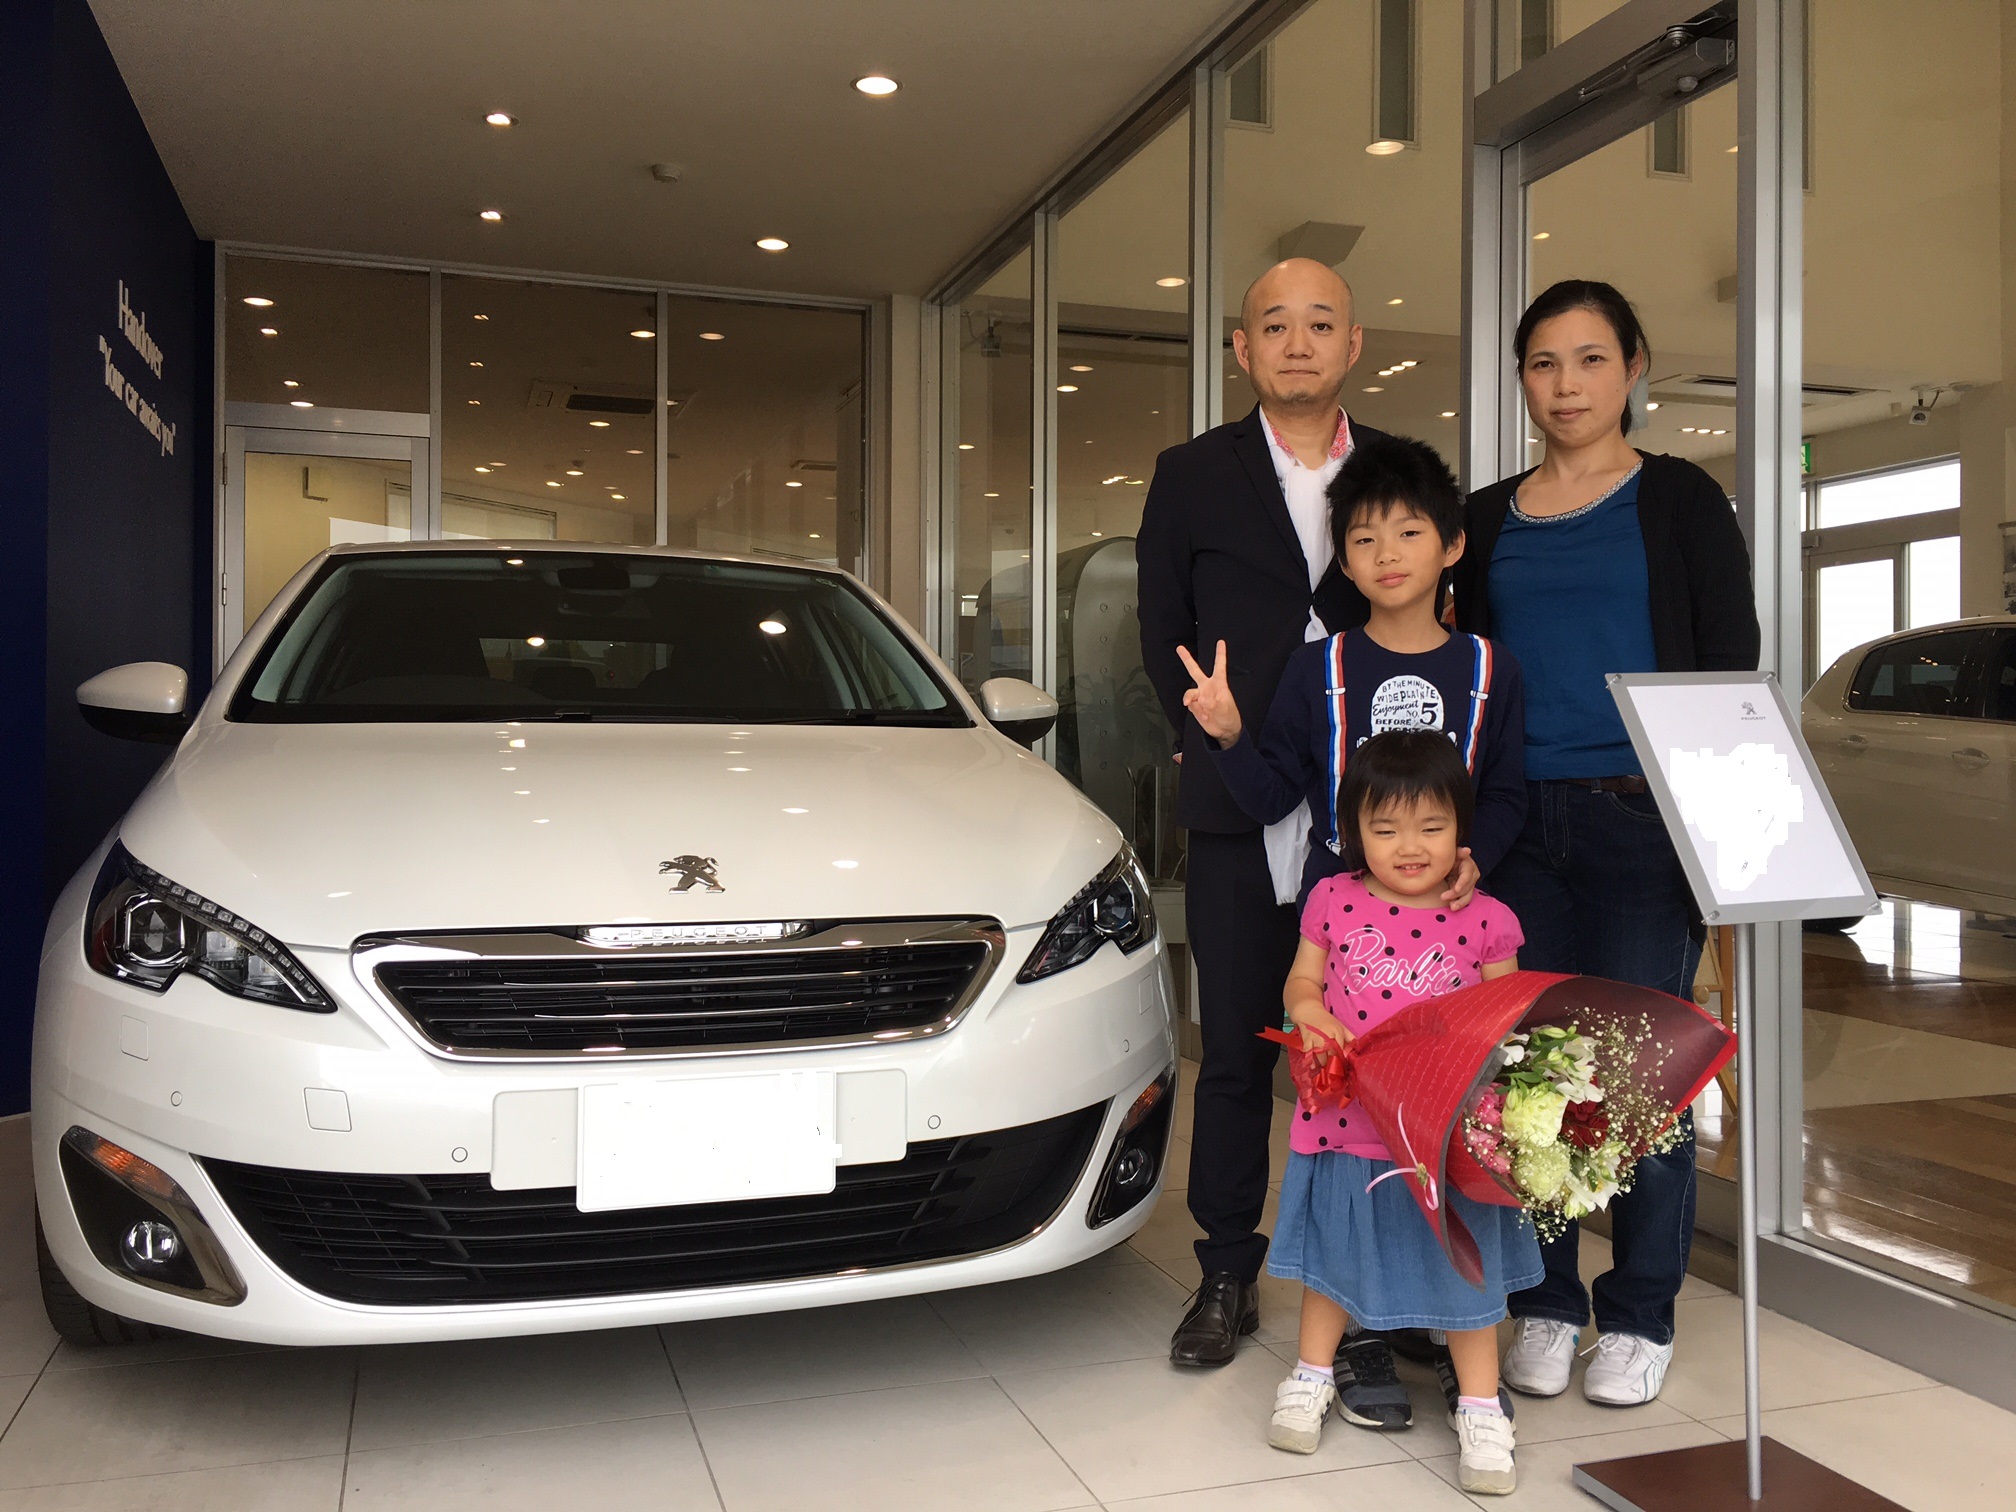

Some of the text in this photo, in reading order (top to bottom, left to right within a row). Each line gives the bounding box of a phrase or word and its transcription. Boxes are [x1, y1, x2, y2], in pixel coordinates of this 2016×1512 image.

[118, 279, 163, 380] Handover
[1382, 683, 1391, 693] BY
[1393, 680, 1406, 688] THE
[1377, 689, 1425, 703] WIDE PLAIN
[1372, 700, 1419, 716] Enjoyment
[1420, 702, 1438, 725] 5
[1375, 718, 1412, 726] BEFORE
[630, 925, 768, 939] PEUGEOT
[1342, 927, 1467, 996] Barbie
